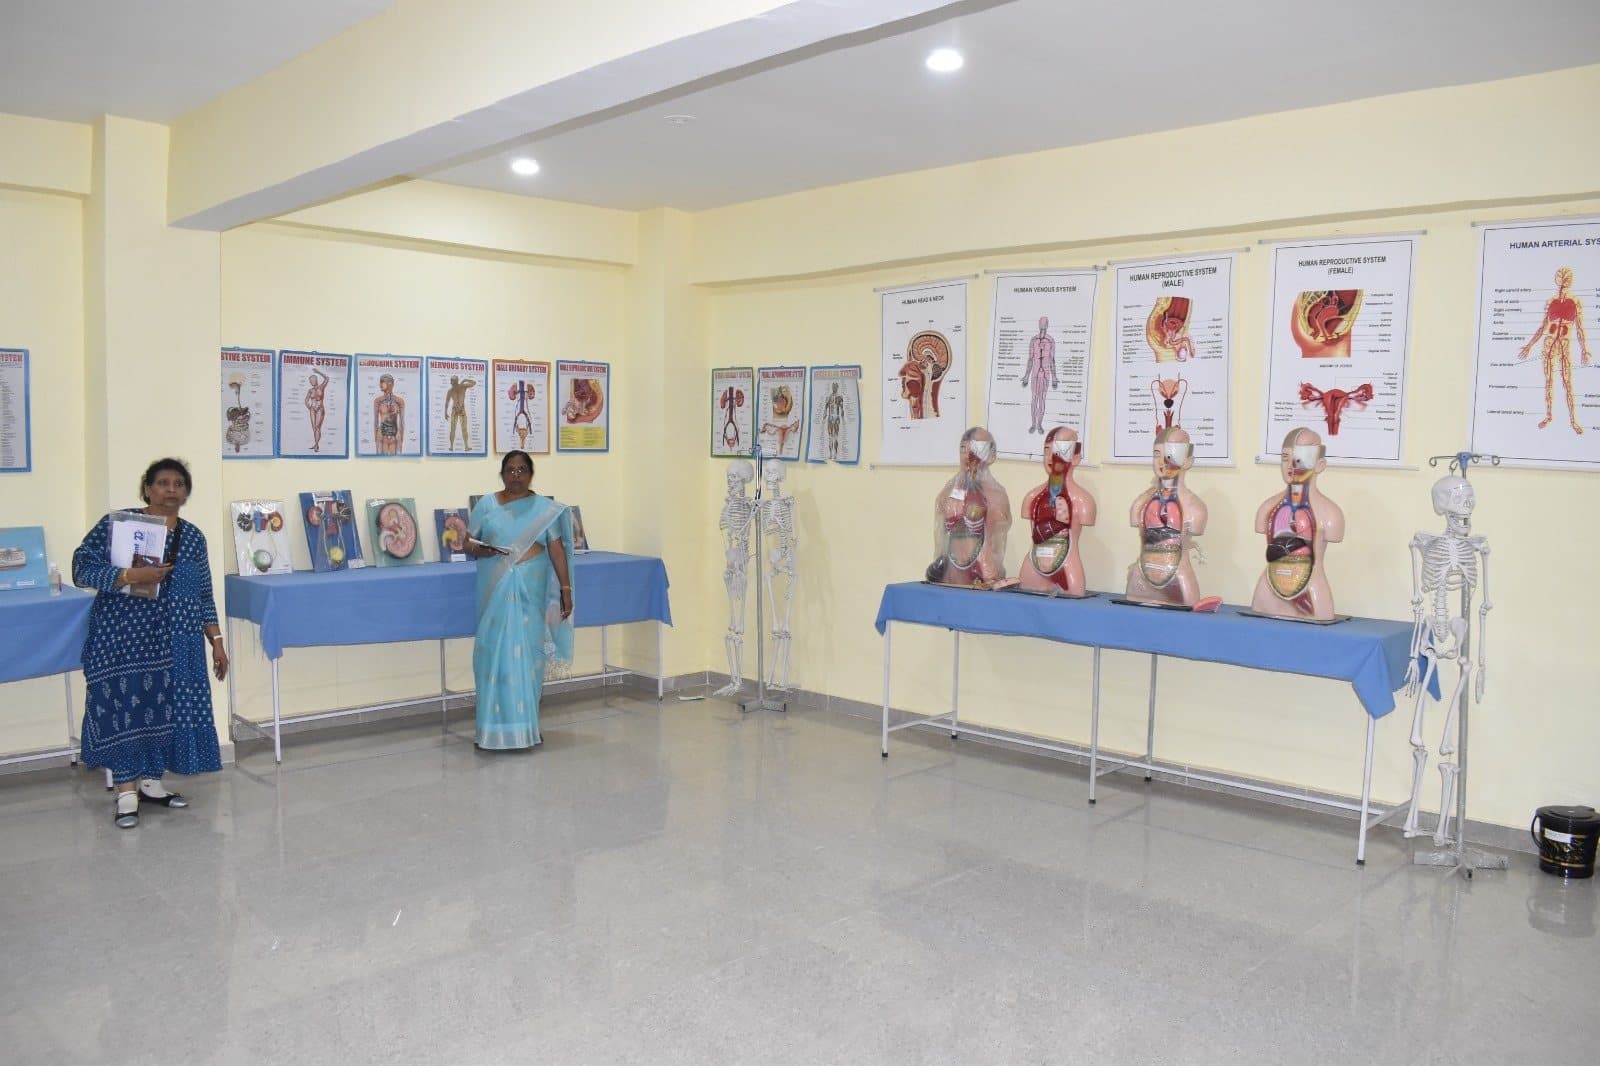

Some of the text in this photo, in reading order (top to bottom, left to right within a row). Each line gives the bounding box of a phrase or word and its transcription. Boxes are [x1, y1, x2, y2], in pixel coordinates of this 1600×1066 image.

[1542, 239, 1582, 248] ARTERIAL
[1298, 256, 1387, 267] HUMAN REPRODUCTIVE SYSTEM
[1150, 270, 1194, 280] REPRODUCTIVE
[1195, 266, 1217, 276] SYSTEM
[1328, 268, 1354, 276] (FEMALE)
[1162, 280, 1184, 288] (MALE)
[242, 353, 271, 363] SYSTEM
[283, 355, 347, 367] IMMUNE SYSTEM
[394, 360, 419, 368] SYSTEM
[430, 361, 485, 371] NERVOUS SYSTEM
